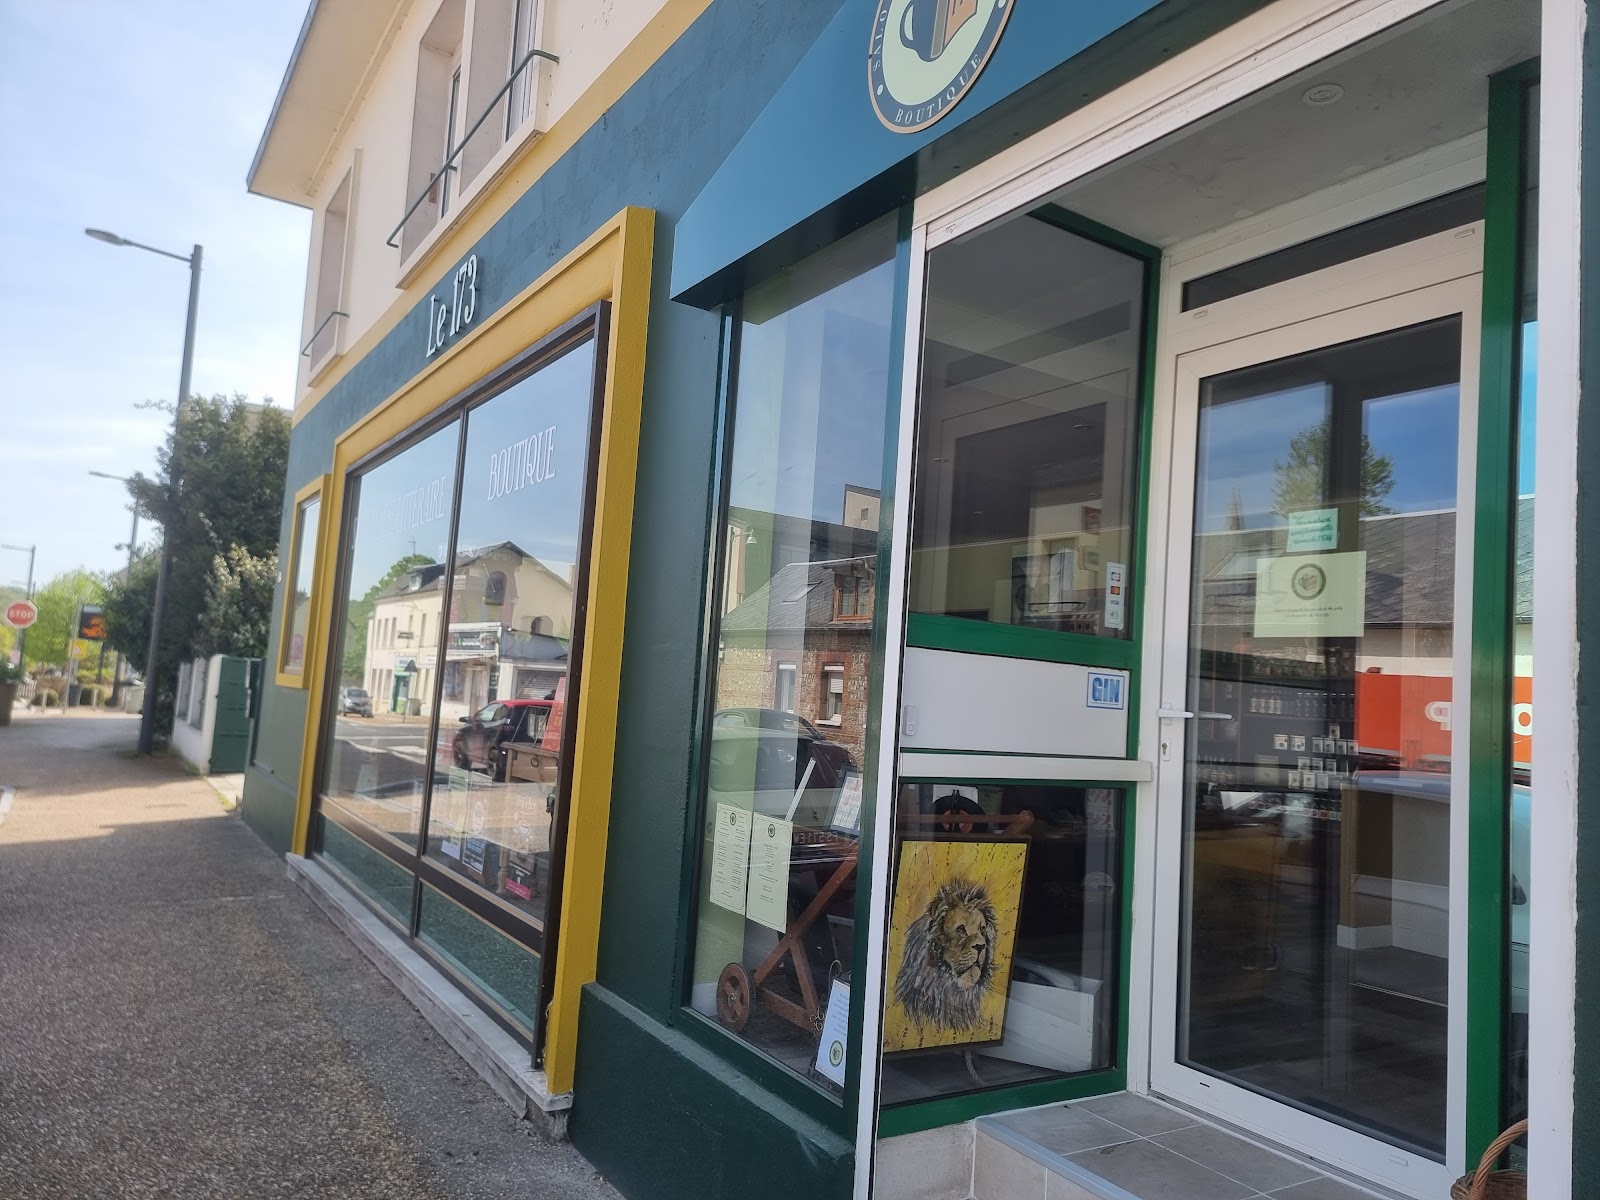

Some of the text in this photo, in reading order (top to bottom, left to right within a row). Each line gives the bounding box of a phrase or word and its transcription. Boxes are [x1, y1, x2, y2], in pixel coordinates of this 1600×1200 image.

[895, 54, 981, 125] BOUTIQUE
[426, 254, 478, 358] Le 173
[487, 425, 557, 501] BOUTIQUE
[9, 609, 34, 619] STOP
